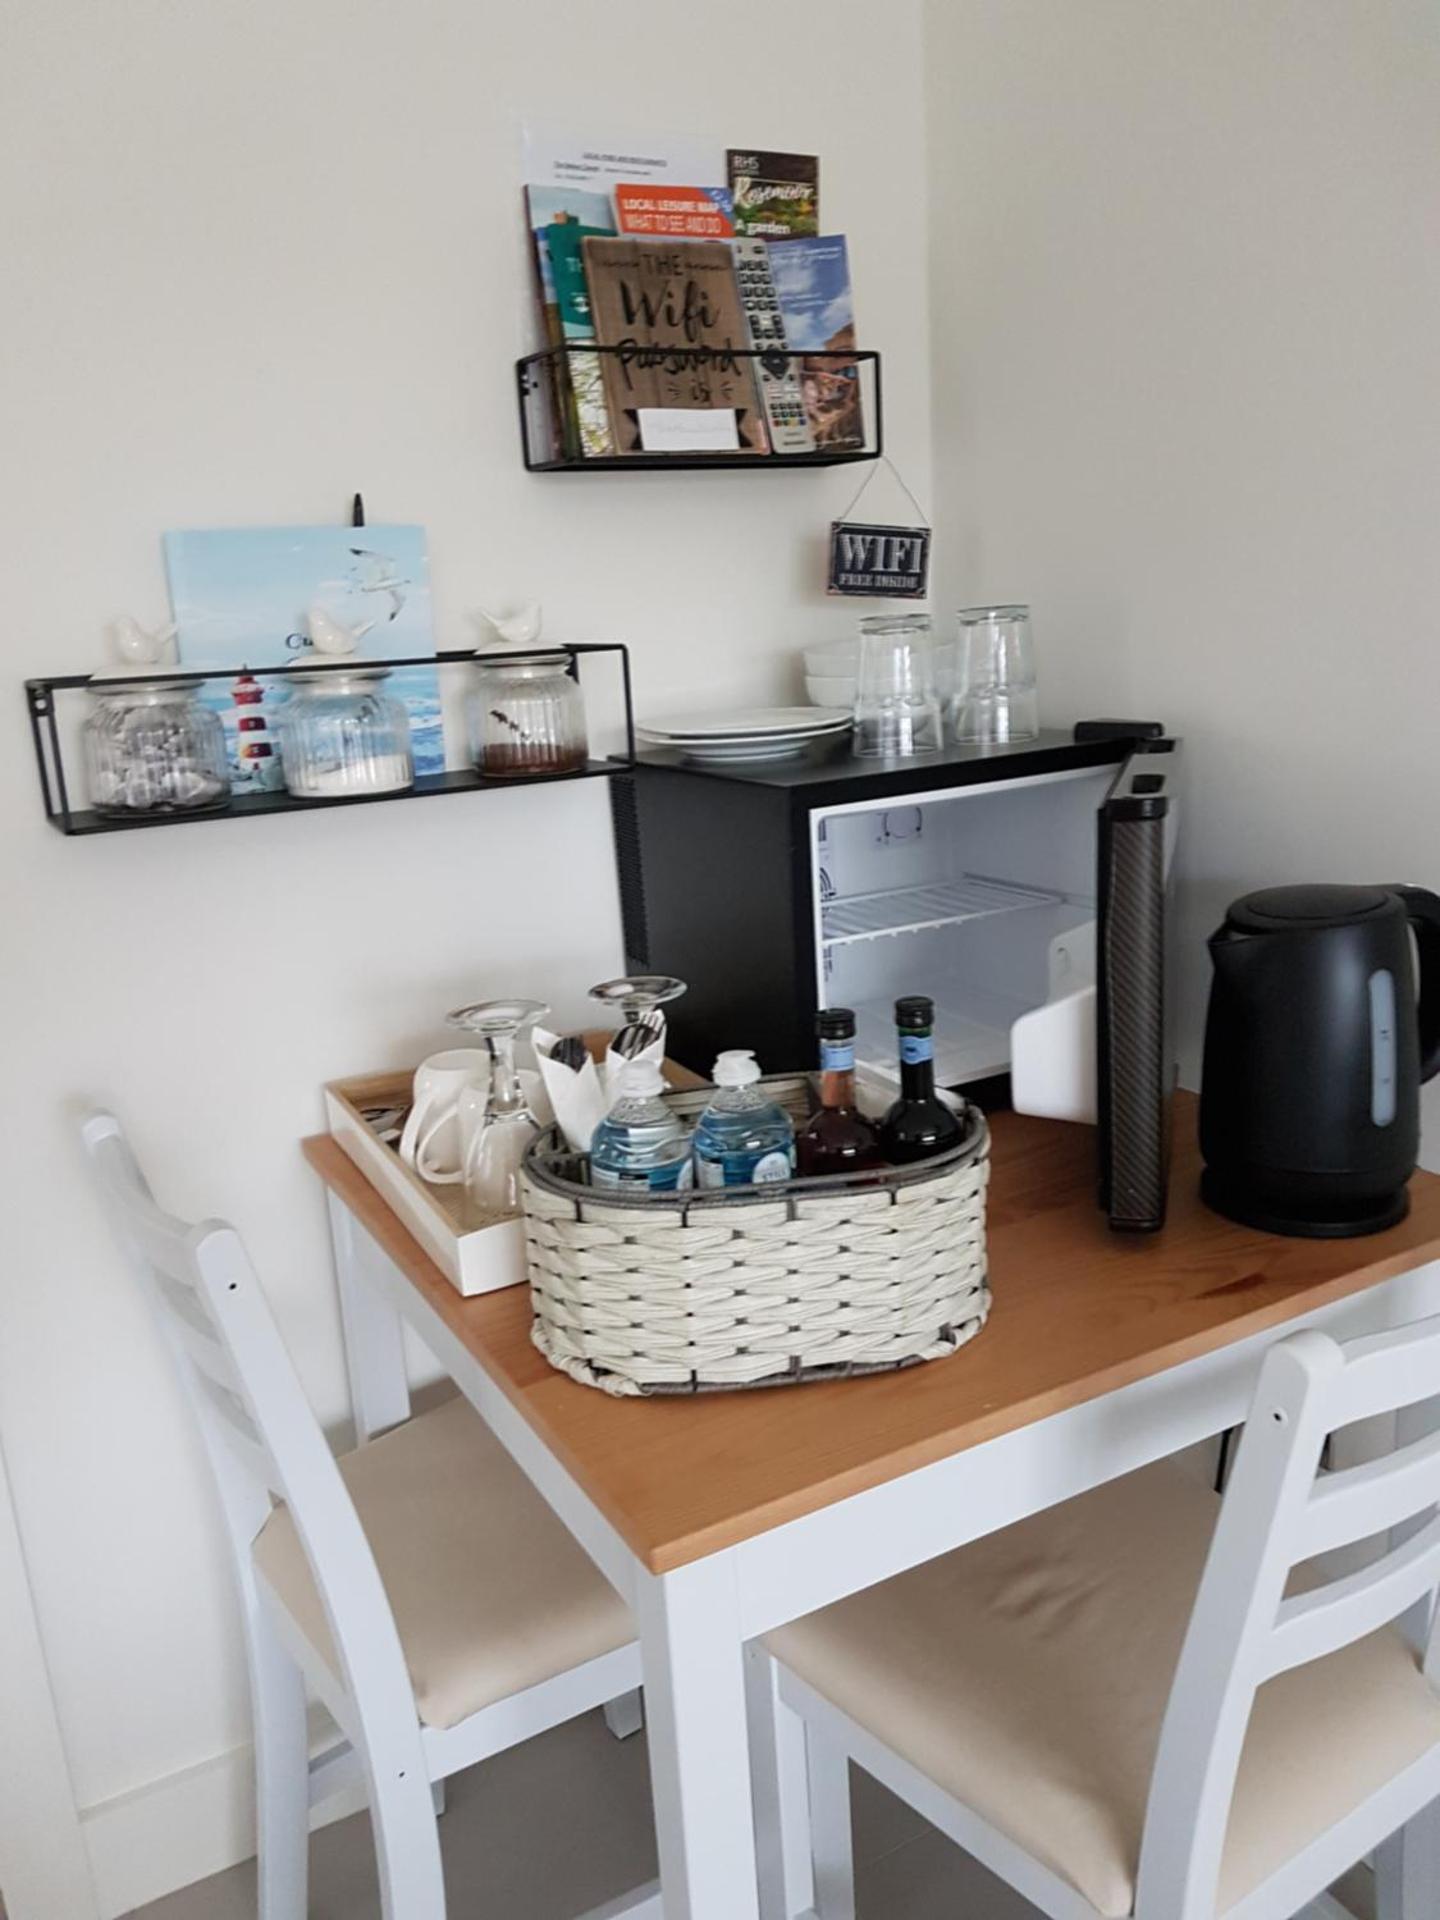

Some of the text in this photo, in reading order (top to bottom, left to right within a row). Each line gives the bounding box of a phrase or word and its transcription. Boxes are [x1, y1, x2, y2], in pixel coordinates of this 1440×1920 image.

[734, 156, 759, 169] RHS
[623, 198, 656, 211] LOCAL
[657, 200, 697, 212] LEISURE
[625, 213, 655, 230] WHAT
[747, 220, 791, 237] garden
[641, 253, 683, 276] THE
[620, 280, 721, 343] Wifi
[840, 534, 922, 572] WIFI
[840, 574, 918, 588] FREE INSIDE
